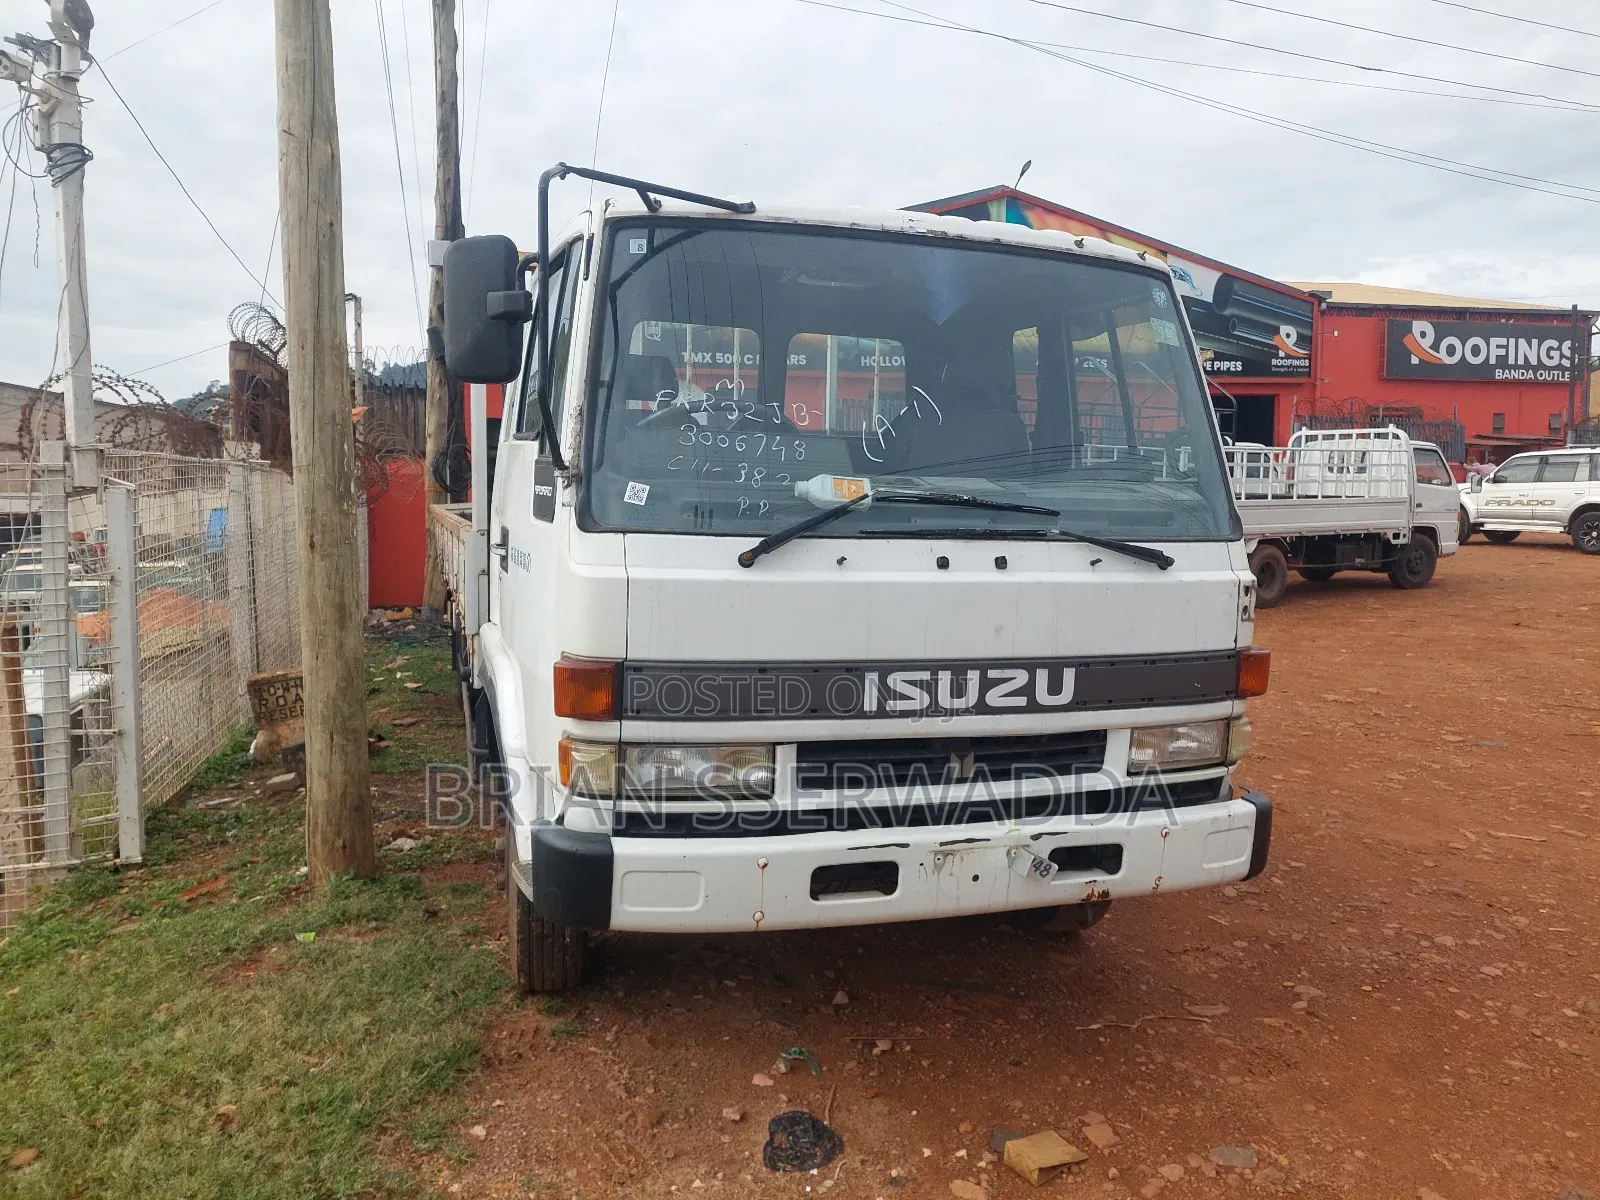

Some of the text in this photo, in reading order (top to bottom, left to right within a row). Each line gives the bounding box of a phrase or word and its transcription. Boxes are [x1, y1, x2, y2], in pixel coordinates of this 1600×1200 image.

[1408, 320, 1578, 367] ROOFINGS
[715, 353, 741, 364] 50
[1271, 358, 1310, 367] ROOFINGS
[1213, 360, 1243, 371] PIPES
[1495, 369, 1577, 382] BANDA OUTLE
[1484, 499, 1556, 507] PRADO
[863, 667, 1076, 712] ISUZU
